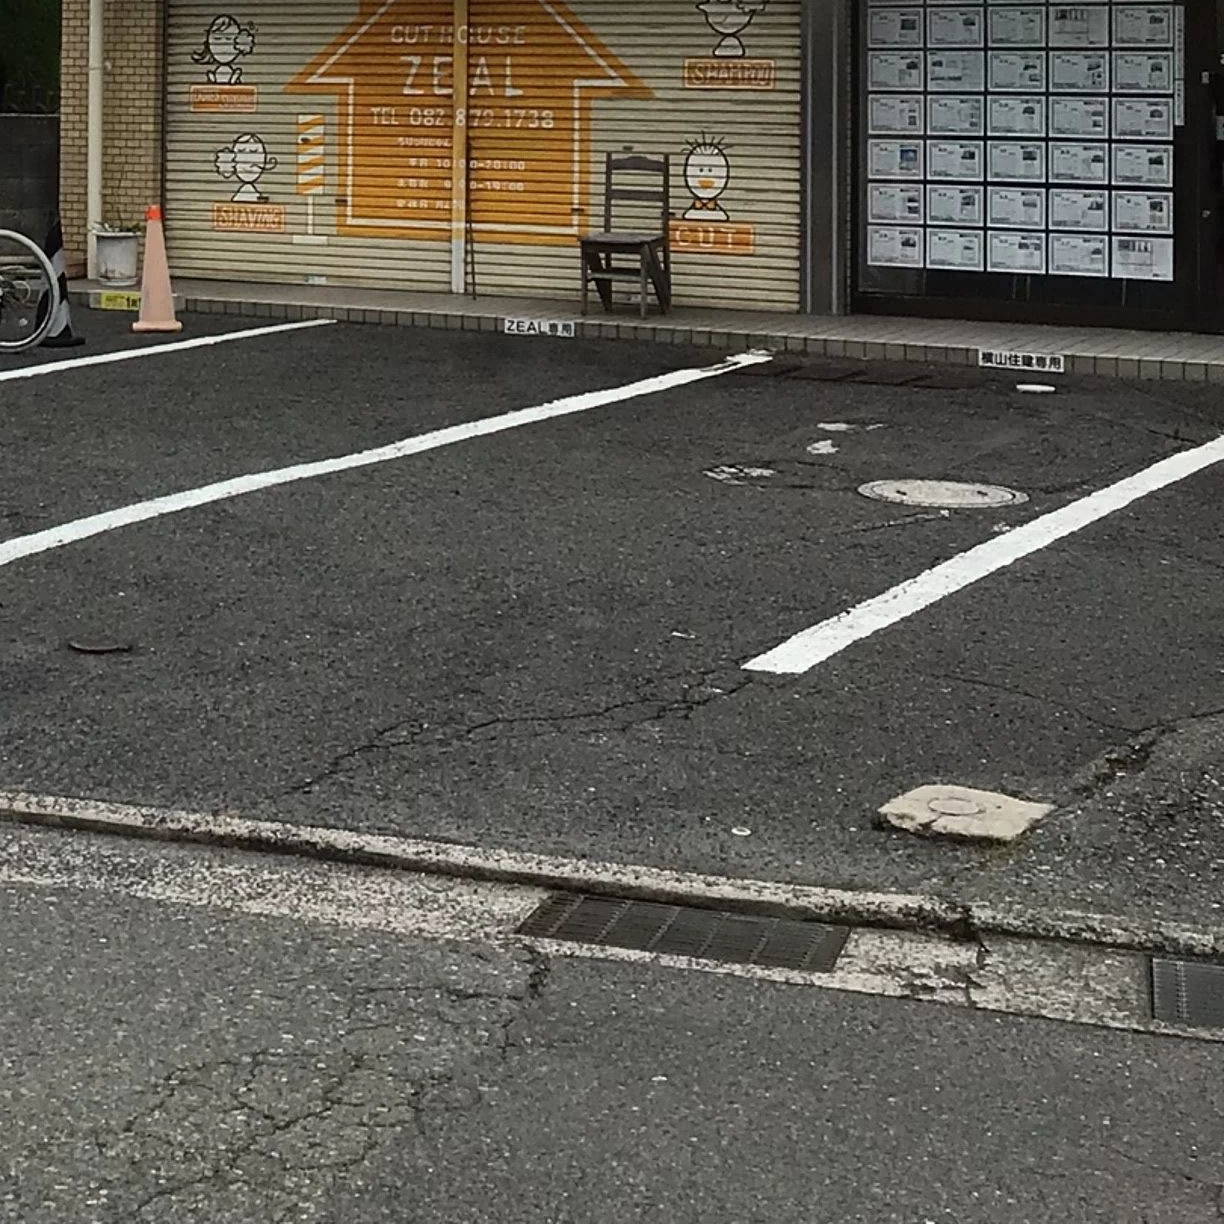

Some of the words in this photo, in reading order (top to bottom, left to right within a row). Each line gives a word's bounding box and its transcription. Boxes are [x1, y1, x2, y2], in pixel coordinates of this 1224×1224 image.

[391, 25, 431, 44] CUT
[400, 56, 524, 96] ZEAL
[676, 226, 737, 249] CUT
